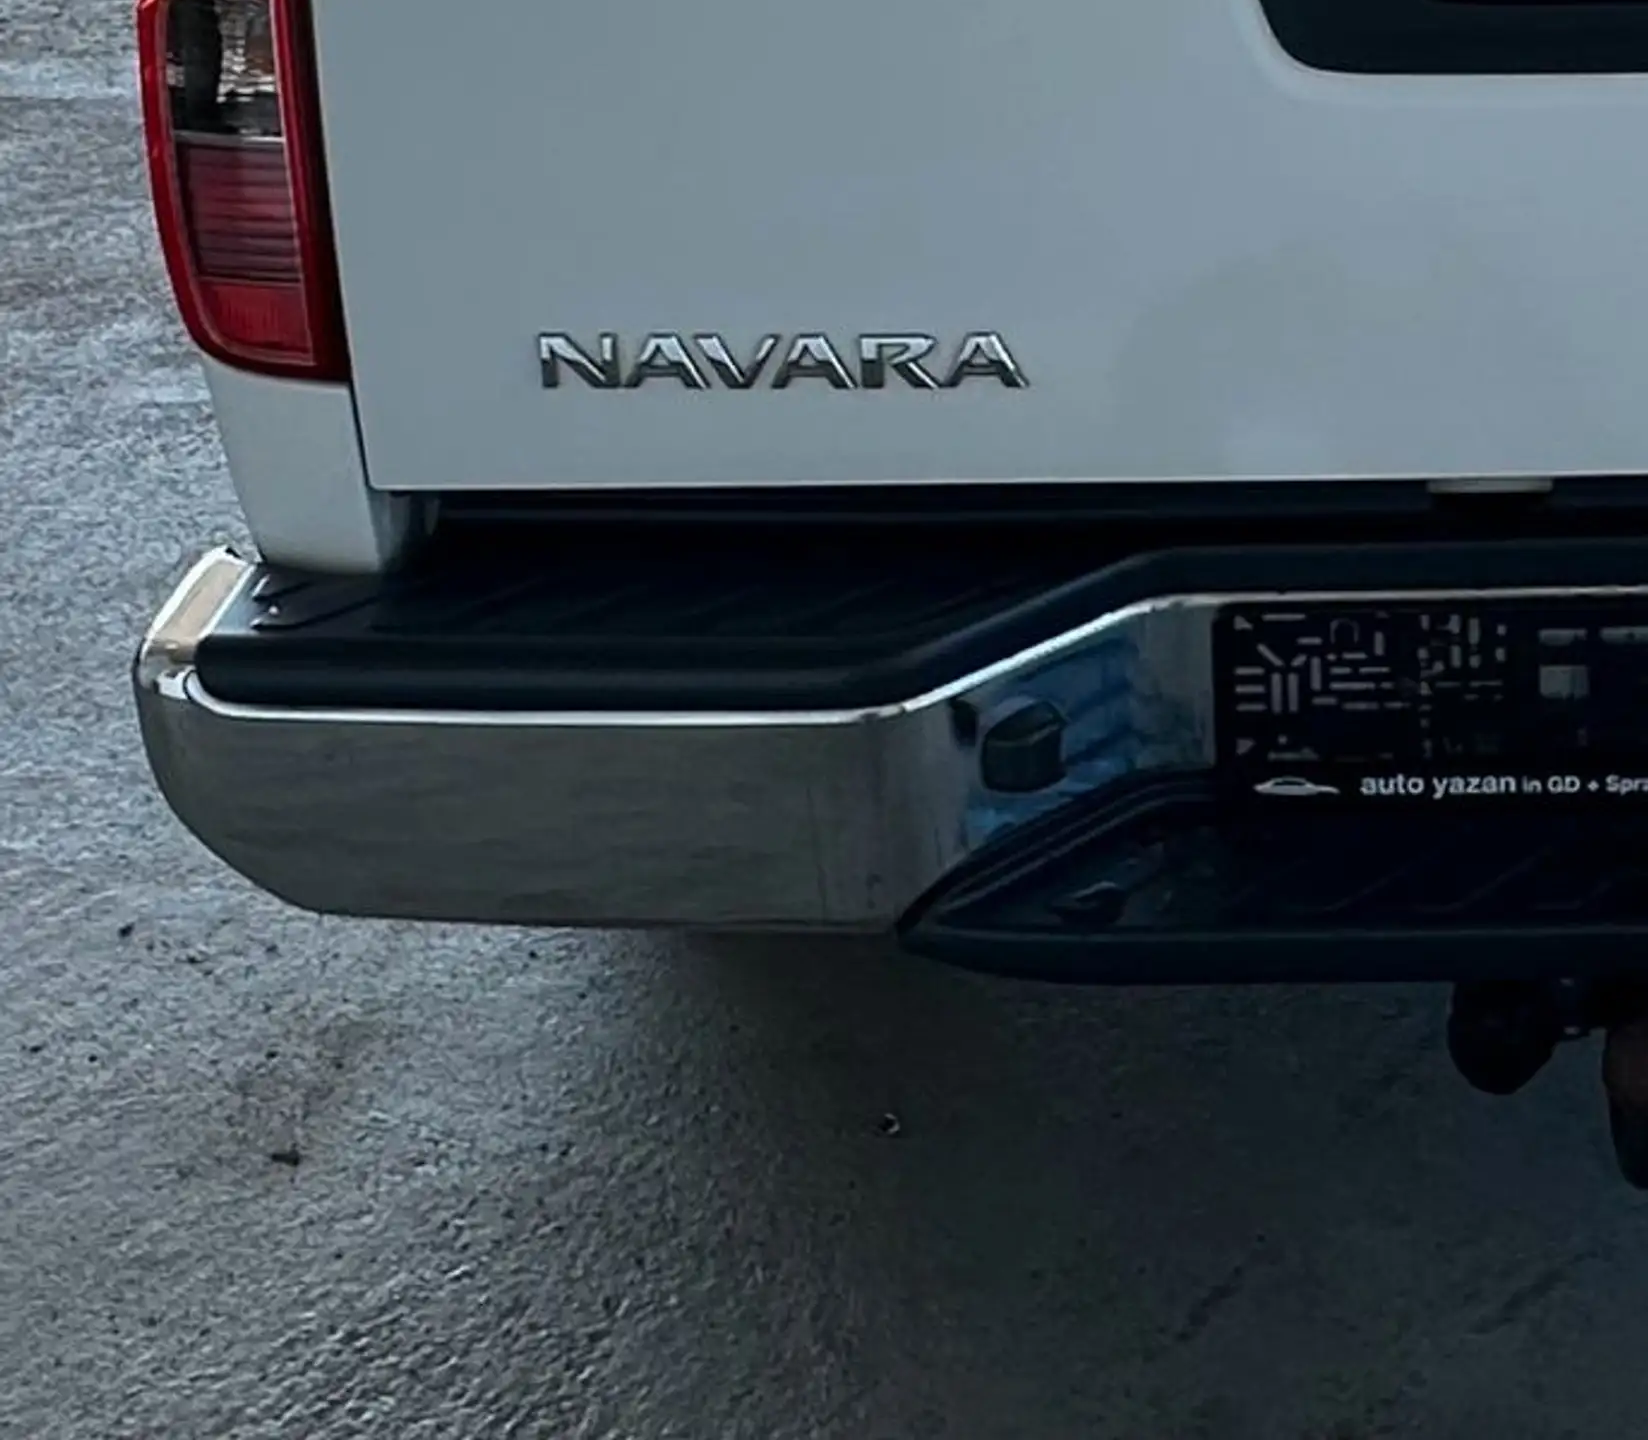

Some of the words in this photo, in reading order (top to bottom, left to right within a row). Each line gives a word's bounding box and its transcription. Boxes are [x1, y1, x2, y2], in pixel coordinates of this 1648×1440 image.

[536, 330, 1030, 390] NAVARA
[1359, 773, 1424, 795] auto
[1432, 775, 1516, 799] yazan
[1522, 777, 1542, 792] in
[1547, 775, 1580, 793] GD
